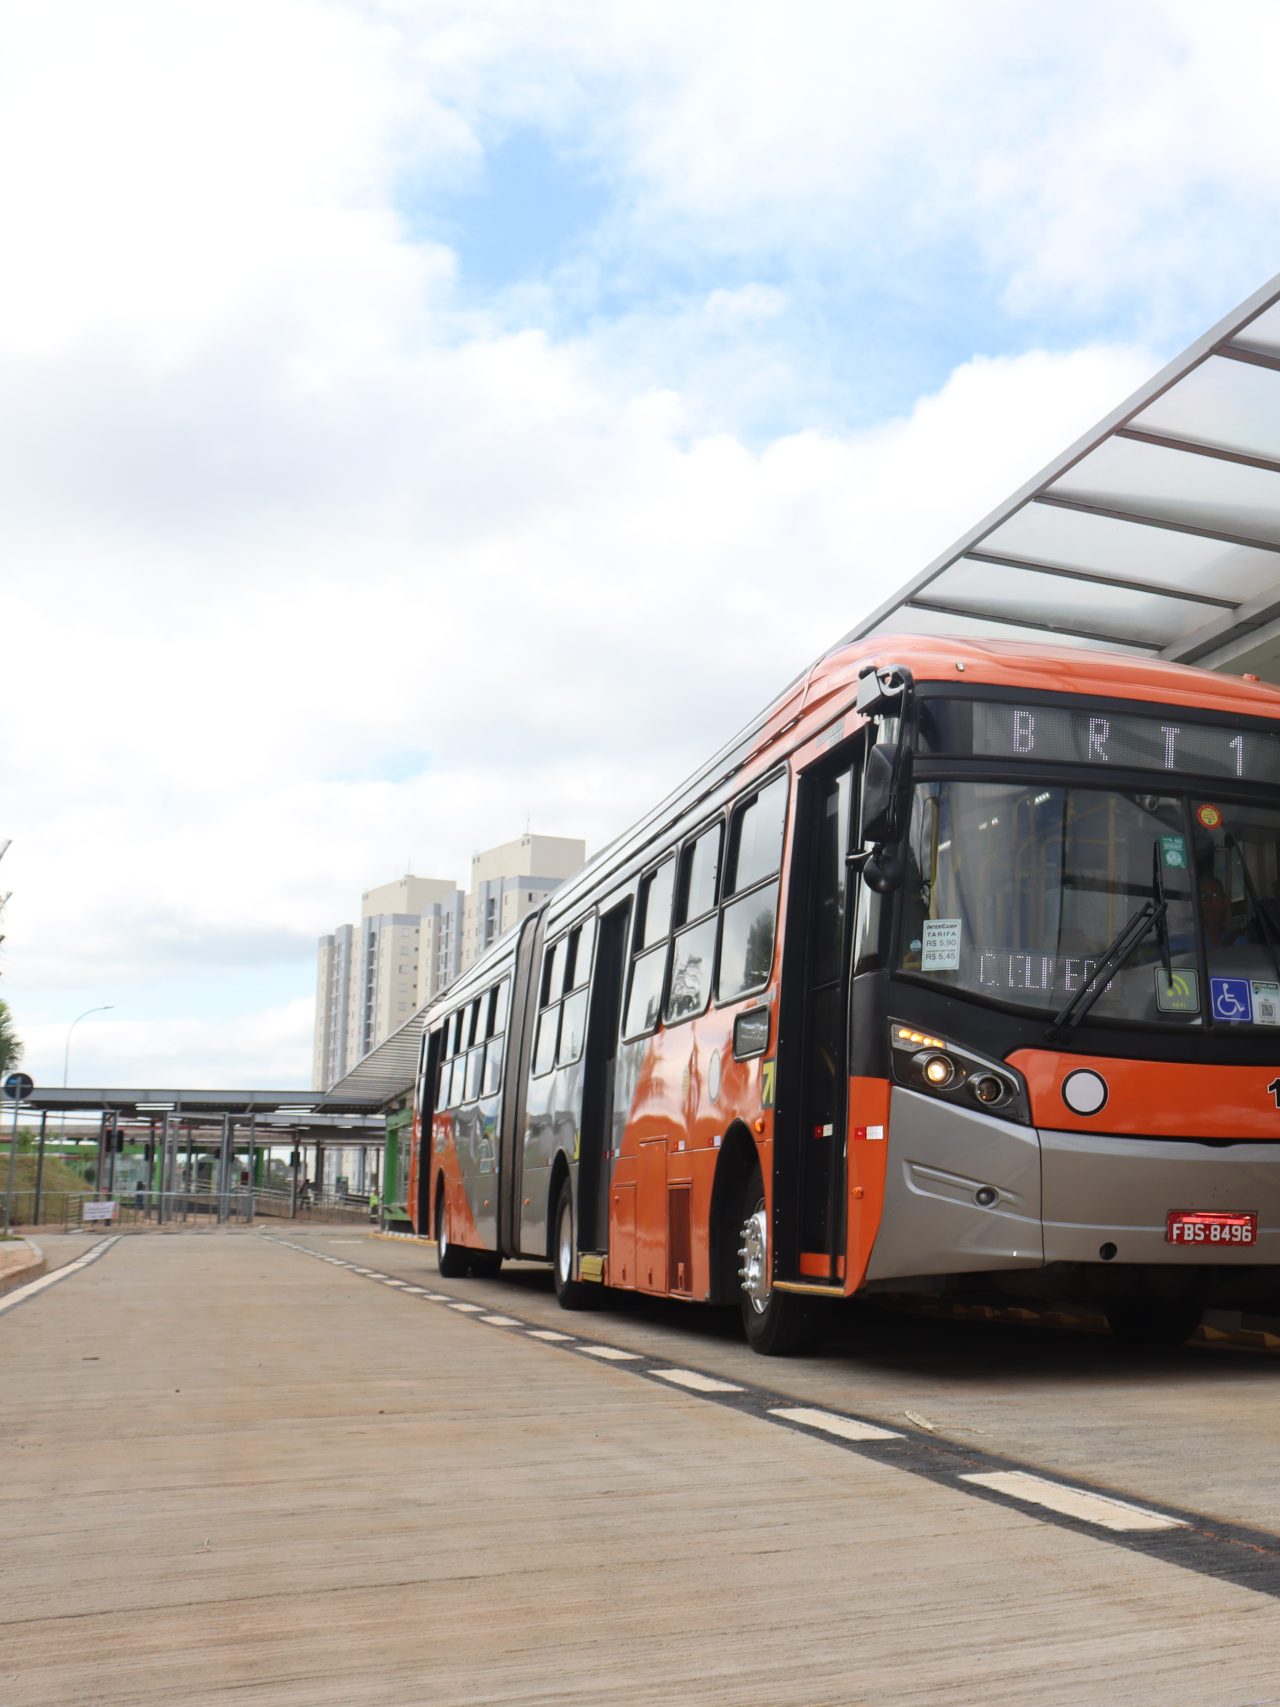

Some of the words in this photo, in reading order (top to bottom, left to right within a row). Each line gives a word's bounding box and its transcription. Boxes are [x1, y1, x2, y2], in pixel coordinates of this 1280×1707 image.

[926, 939, 937, 947] R$
[938, 939, 957, 947] 5,90
[938, 952, 956, 960] 5,45
